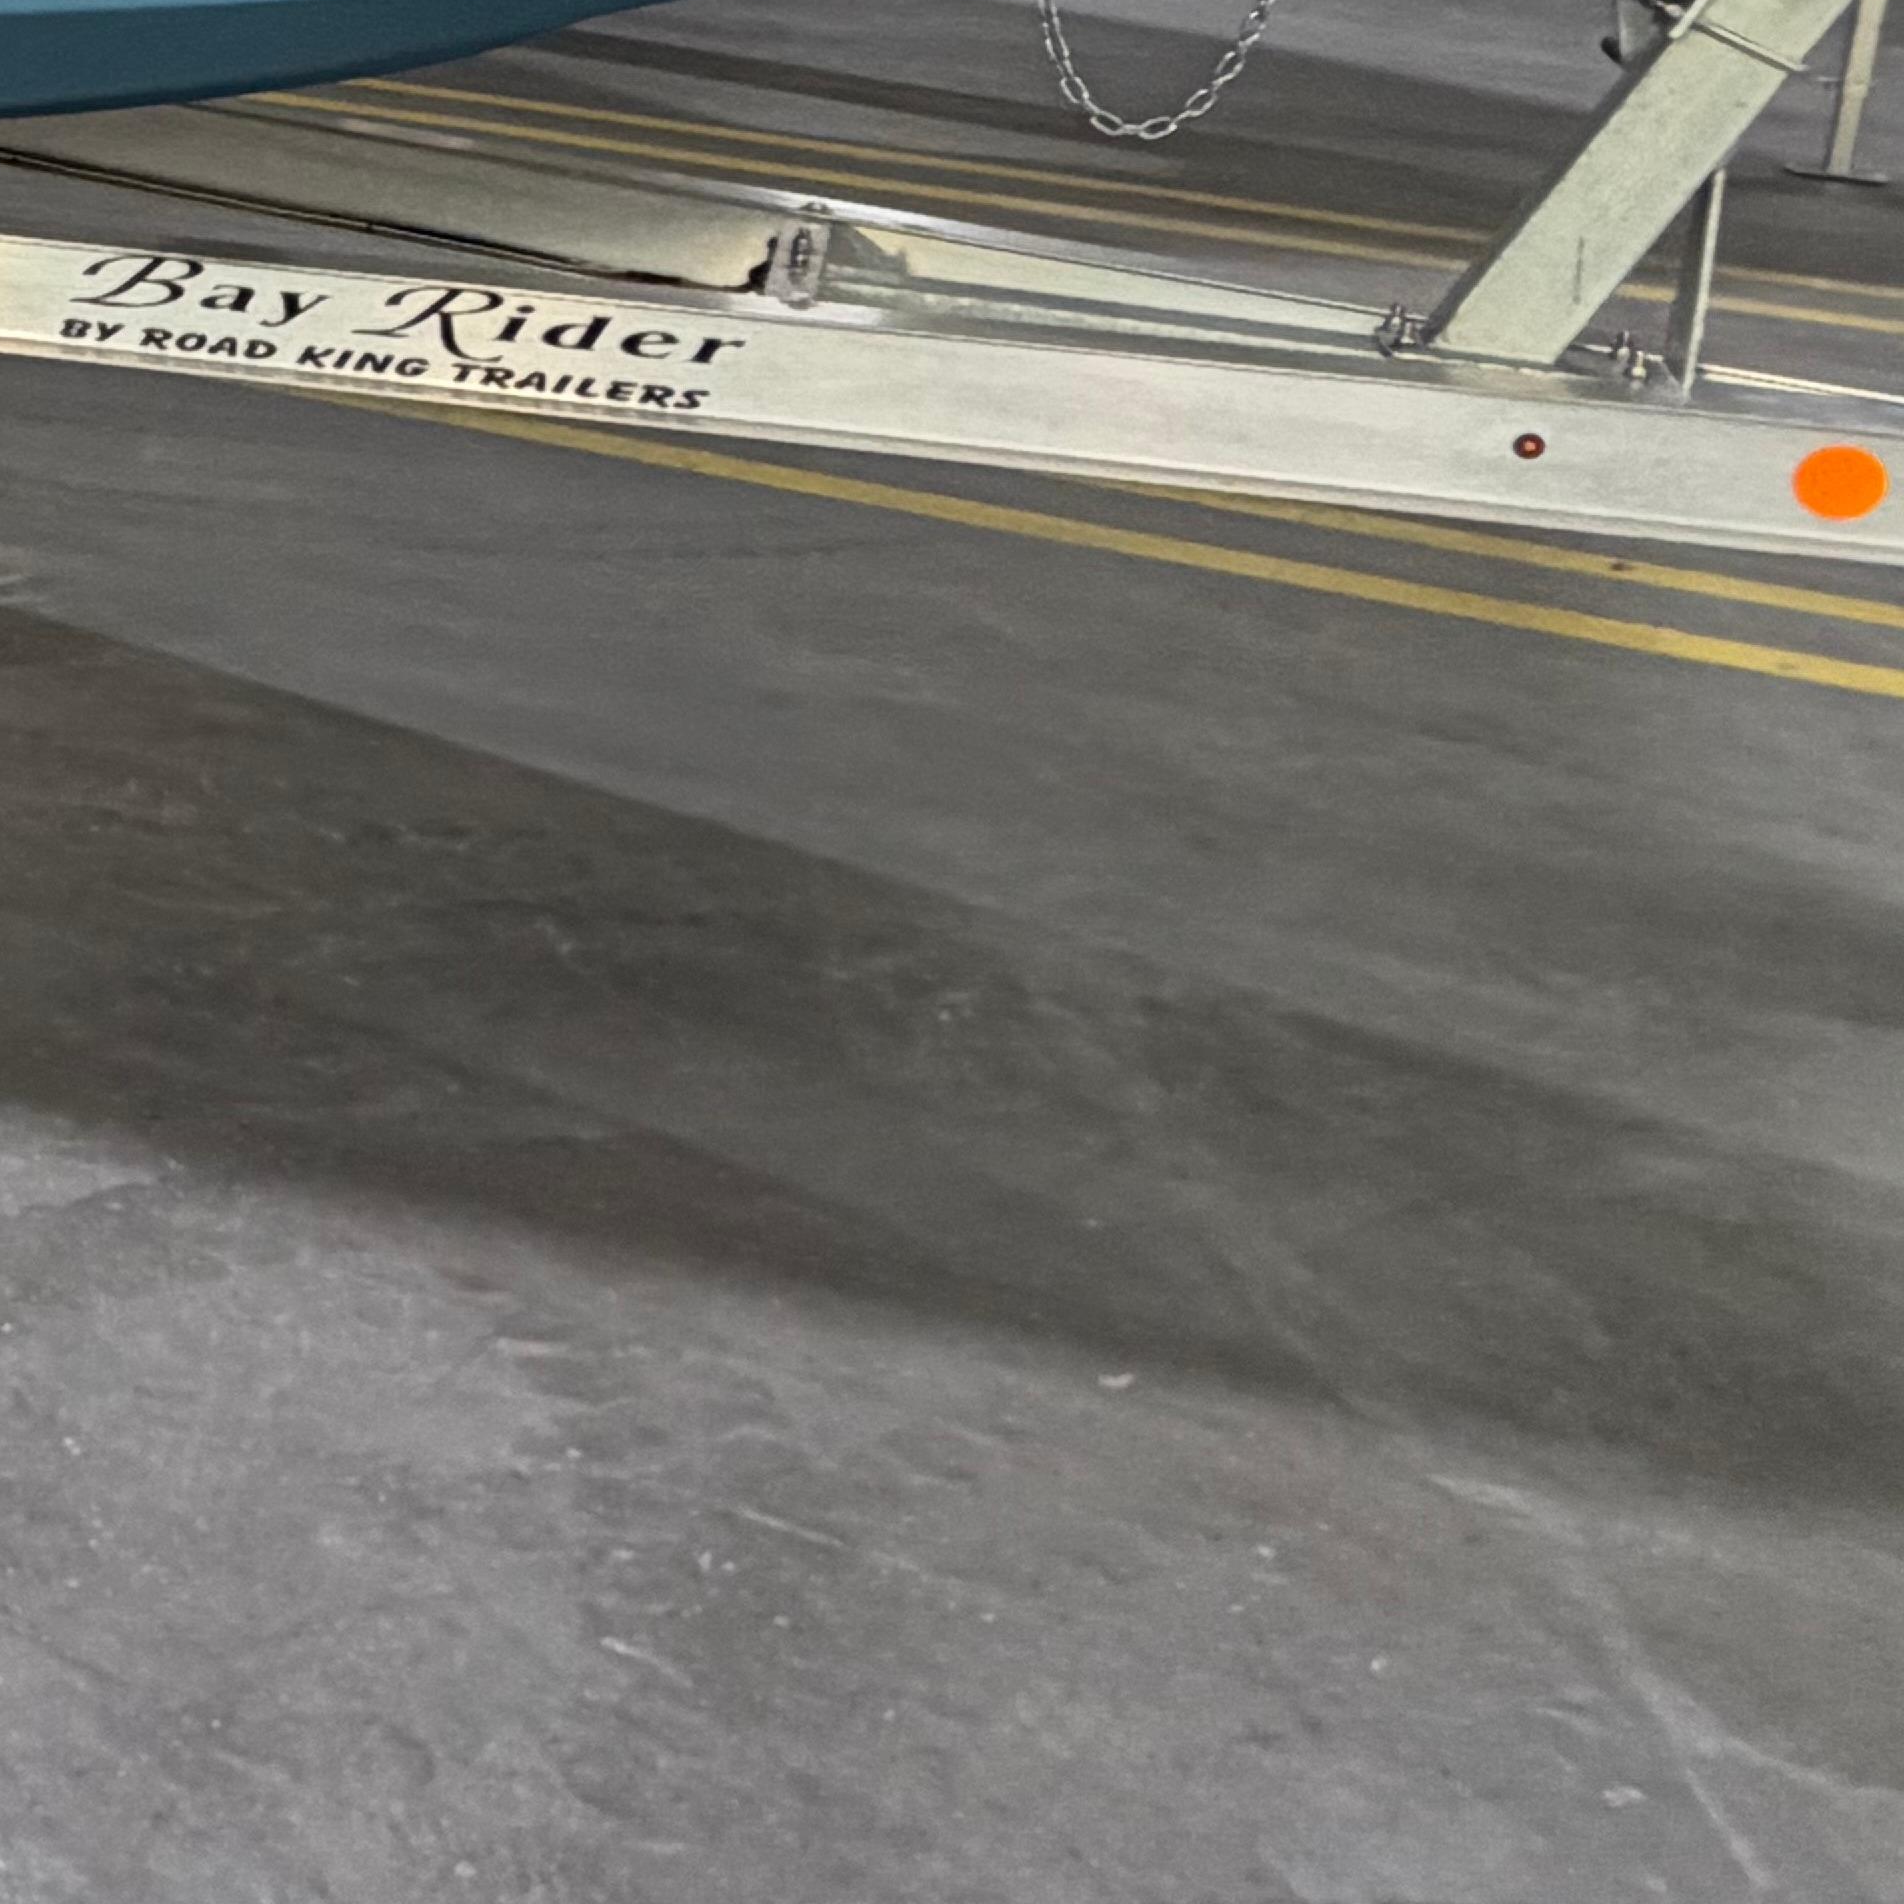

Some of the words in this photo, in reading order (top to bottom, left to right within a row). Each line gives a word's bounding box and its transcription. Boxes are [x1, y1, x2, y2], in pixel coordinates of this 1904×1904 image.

[69, 254, 334, 327] Bay
[351, 286, 746, 364] Rider
[60, 319, 125, 342] BY
[139, 327, 277, 359] ROAD
[296, 345, 429, 377] KING
[451, 363, 710, 409] TRAILERS
